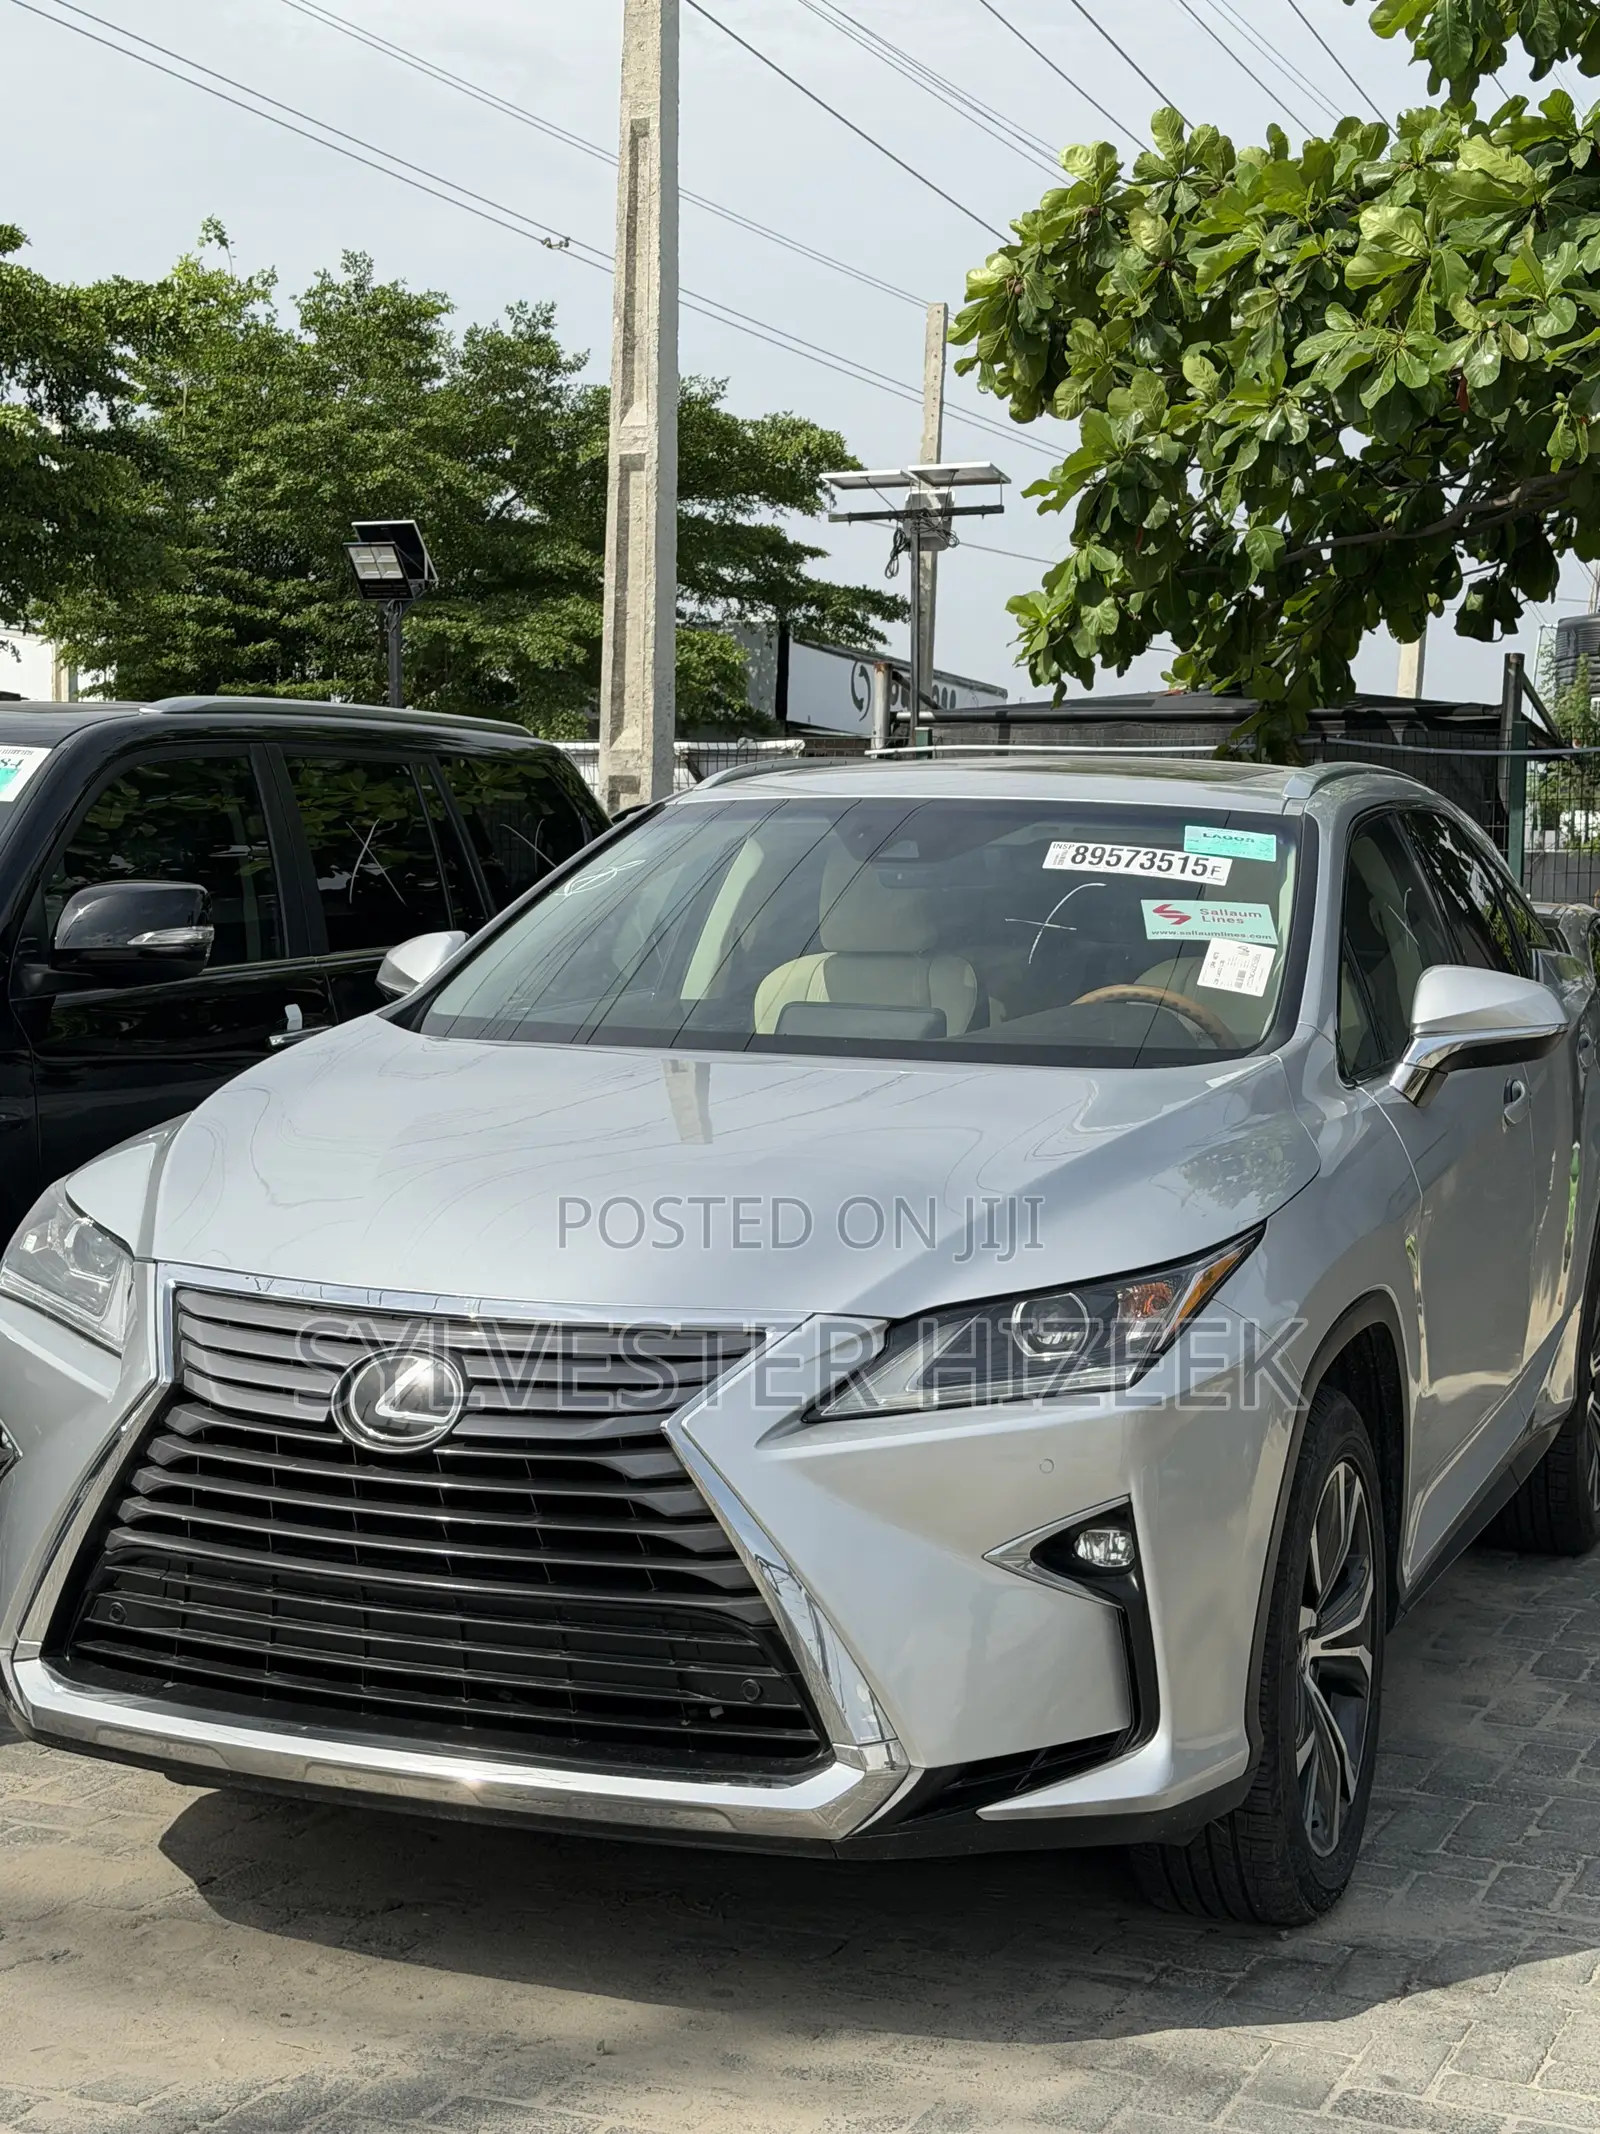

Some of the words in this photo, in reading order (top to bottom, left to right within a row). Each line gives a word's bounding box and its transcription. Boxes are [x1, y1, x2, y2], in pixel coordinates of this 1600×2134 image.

[1070, 844, 1210, 877] 89573515
[1210, 865, 1222, 877] F
[1200, 908, 1262, 918] Sallaum
[1202, 915, 1244, 925] Lines
[1151, 930, 1272, 940] www.sallaumlines.com
